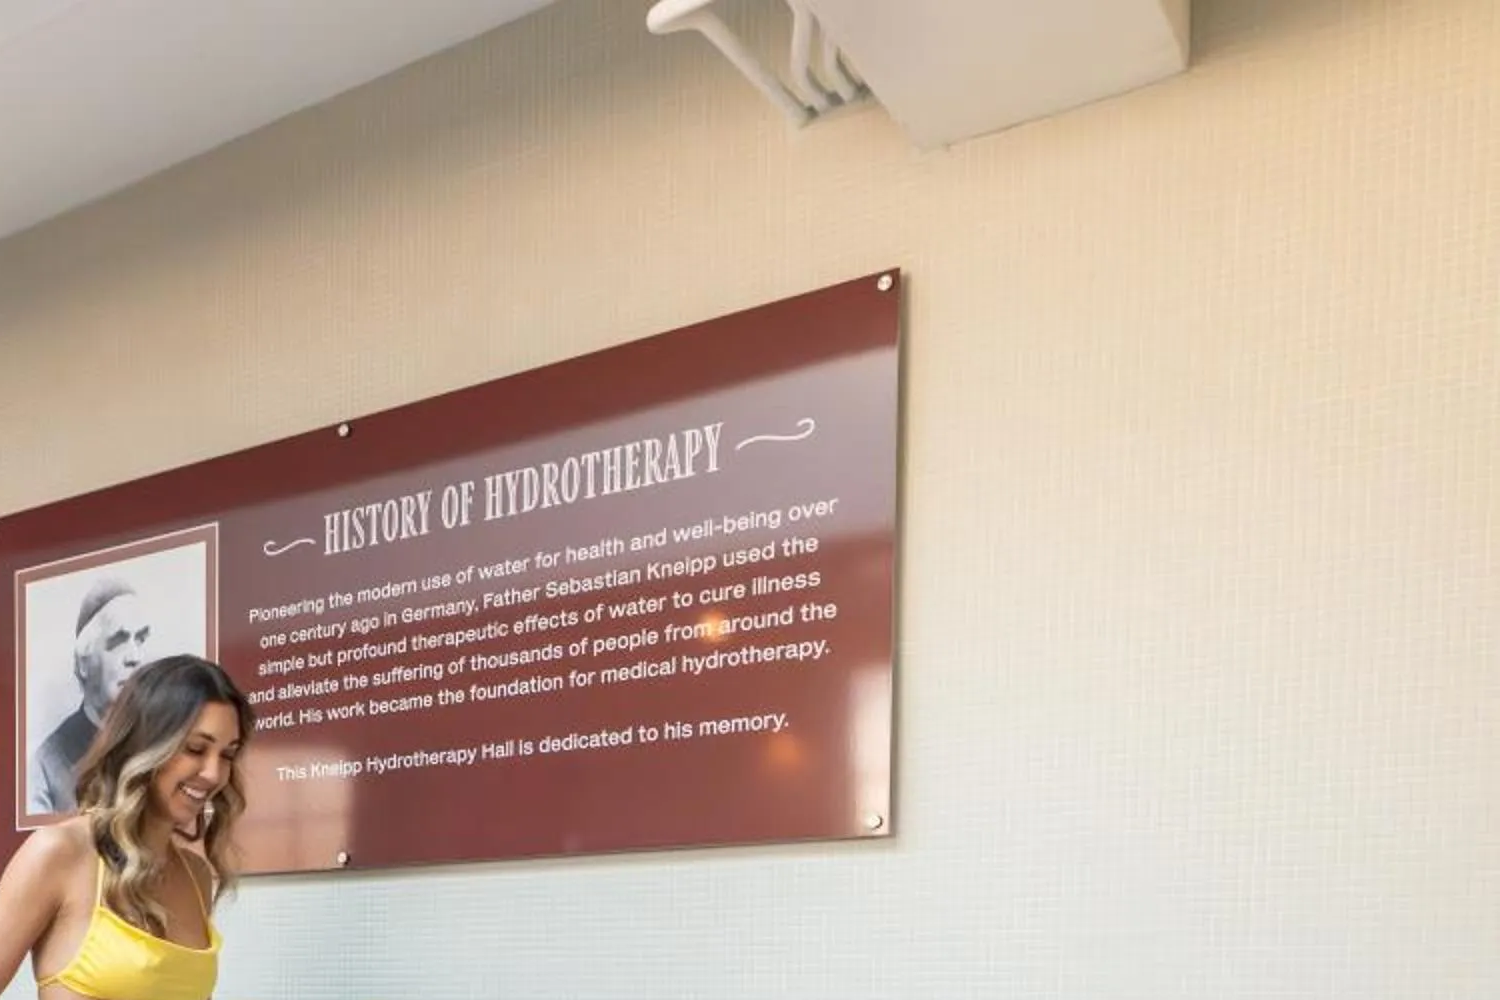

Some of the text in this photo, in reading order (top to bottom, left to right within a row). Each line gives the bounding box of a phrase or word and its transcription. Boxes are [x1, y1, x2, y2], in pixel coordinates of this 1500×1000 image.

[323, 421, 724, 556] HISTORY OF HYDROTHERAPY
[248, 498, 839, 624] Pioneering the modern use of water for health and well-being over
[259, 536, 819, 650] one century ago in Germany, Father Sebastian Kneipp used the
[248, 602, 837, 705] and alleviate the suffering of thousands of people from around the
[258, 571, 821, 677] simple but profound therapeutic effects of water to cure illness
[299, 708, 324, 725] His
[325, 701, 365, 721] work
[369, 694, 434, 715] became
[437, 688, 465, 705] the
[469, 675, 564, 702] foundation
[568, 669, 597, 688] for
[600, 656, 677, 685] medical
[681, 639, 831, 676] hydrotherapy.
[276, 712, 789, 781] This Kneipp Hydrotherapy Hall is dedicated to his memory.
